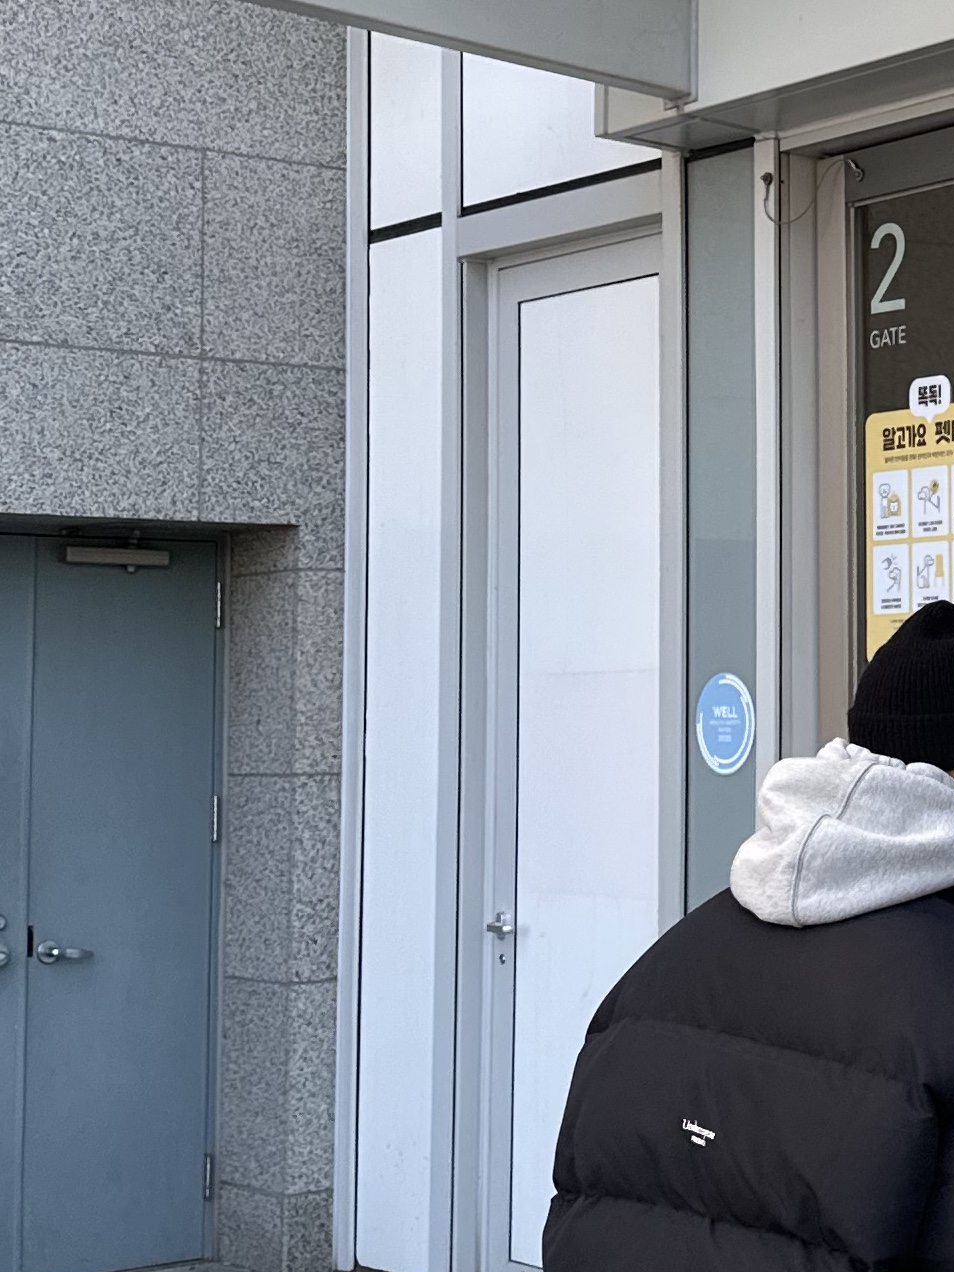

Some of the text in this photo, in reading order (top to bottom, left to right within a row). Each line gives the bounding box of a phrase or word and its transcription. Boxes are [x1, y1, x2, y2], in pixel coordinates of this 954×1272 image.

[870, 222, 906, 315] 2
[869, 325, 907, 349] GATE
[918, 384, 942, 407] 똑똑!
[882, 423, 927, 452] 알고가요
[712, 705, 738, 719] WELL
